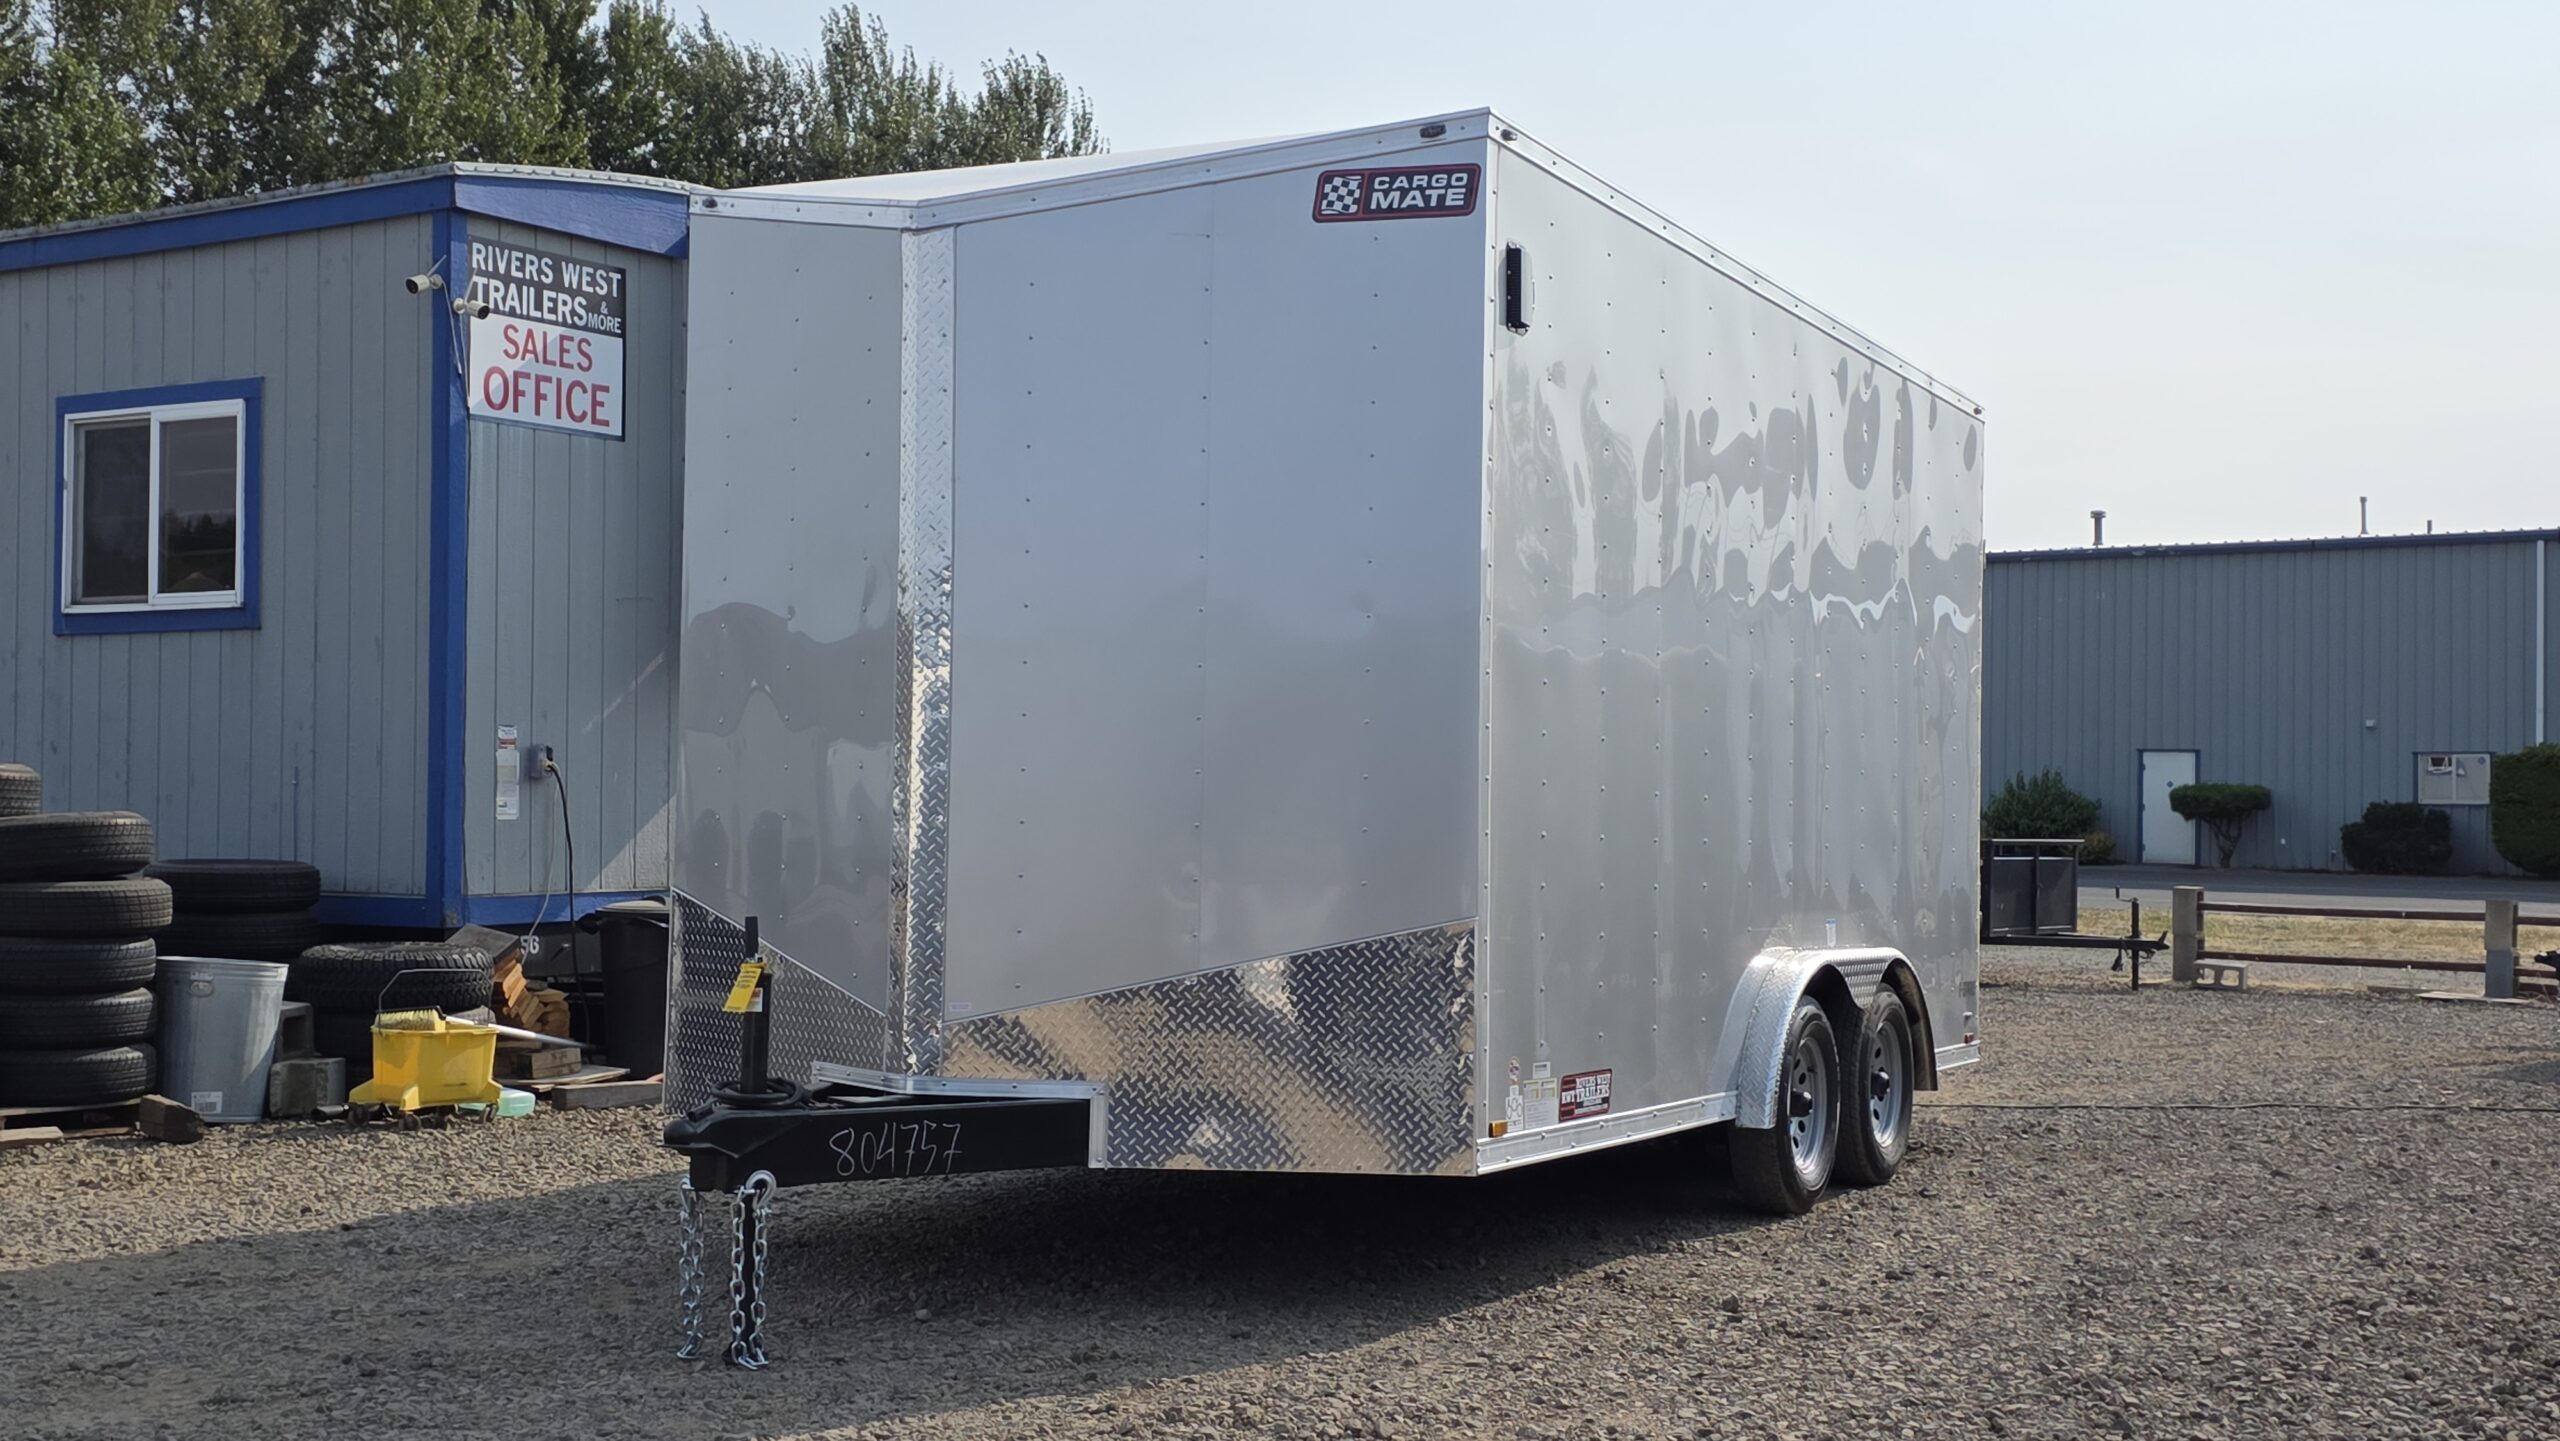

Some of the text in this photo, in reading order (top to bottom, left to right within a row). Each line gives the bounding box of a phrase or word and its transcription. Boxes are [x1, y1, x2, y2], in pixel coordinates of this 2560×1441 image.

[1369, 188, 1467, 210] MATE
[1373, 172, 1469, 190] CARGO
[471, 242, 622, 298] RIVERS WEST
[471, 274, 622, 334] TRAILERS & MORE
[502, 323, 593, 373] SALES
[482, 365, 611, 428] OFFICE
[828, 1119, 963, 1177] 804757
